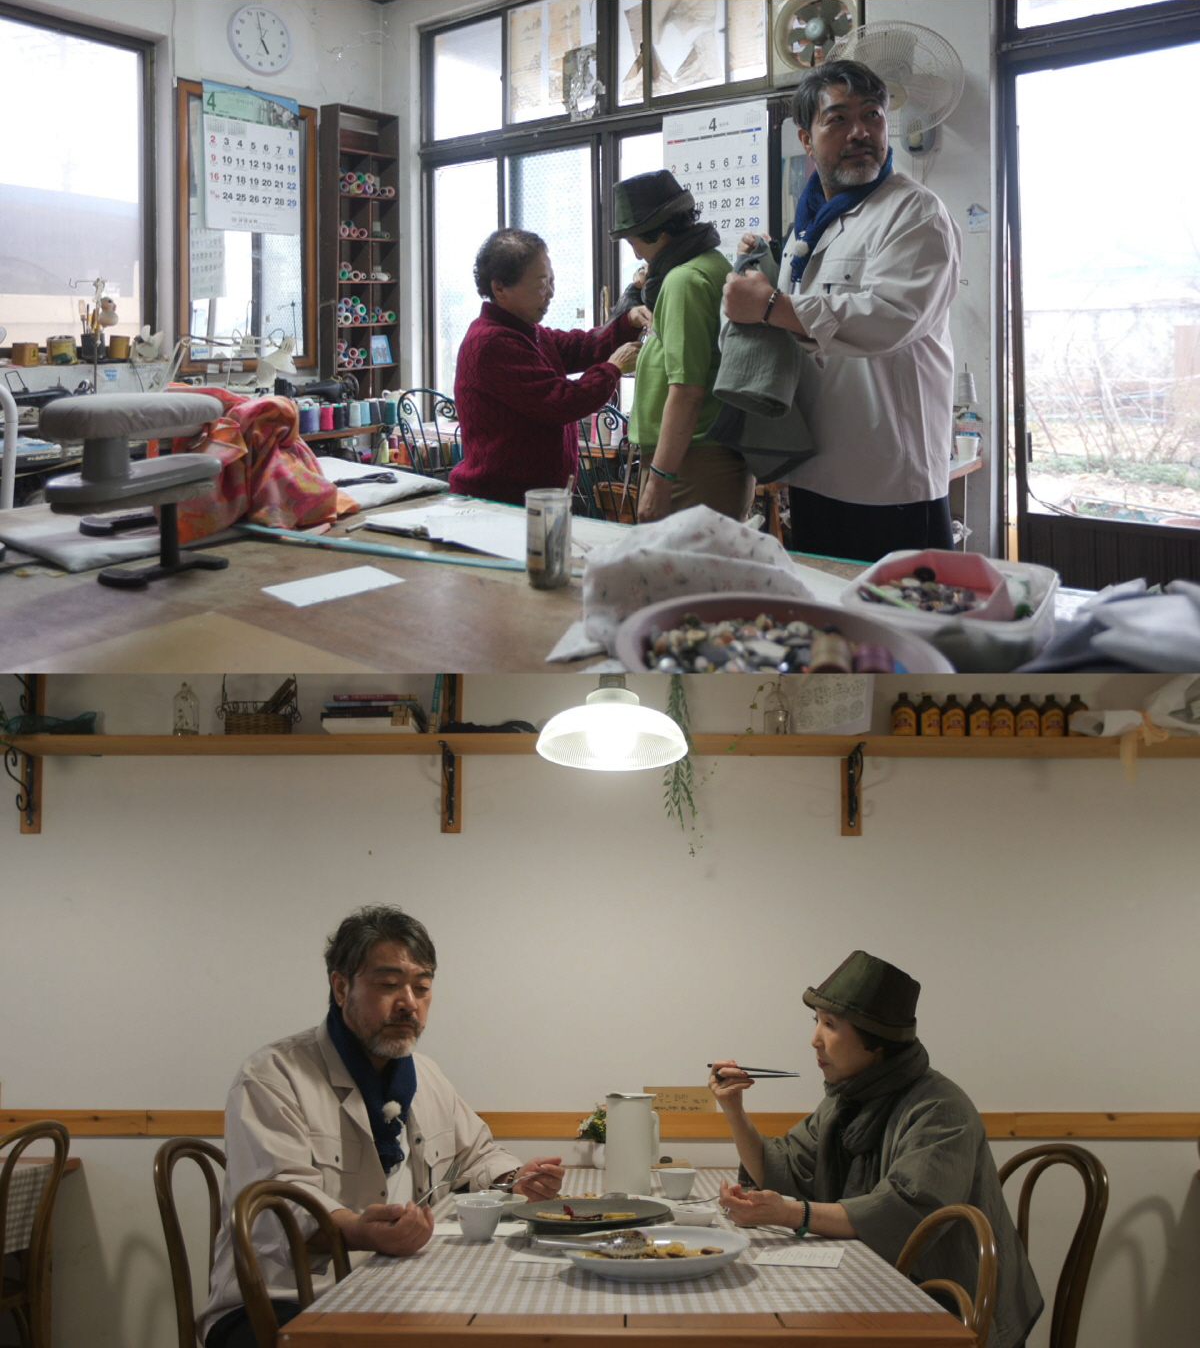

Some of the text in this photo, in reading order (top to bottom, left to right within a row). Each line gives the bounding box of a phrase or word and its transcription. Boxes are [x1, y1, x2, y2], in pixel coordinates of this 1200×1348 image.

[206, 91, 217, 111] 4
[708, 117, 717, 132] 4
[210, 135, 294, 156] 2 3 4 5 6 7 8
[210, 153, 297, 173] 9 10 11 12 13 14 15
[671, 154, 757, 174] 2 3 4 5 6 7 8
[210, 171, 297, 190] 16 17 18 19 20 21 22
[696, 182, 703, 191] 11
[708, 180, 718, 189] 12
[722, 178, 732, 188] 13
[736, 176, 746, 186] 14
[750, 174, 760, 185] 15
[222, 191, 233, 200] 24
[236, 193, 247, 202] 25
[249, 194, 260, 203] 26
[262, 196, 272, 205] 27
[274, 197, 285, 206] 28
[286, 199, 297, 207] 29
[695, 195, 760, 211] 18 19 20 21 22
[721, 218, 731, 229] 27
[734, 217, 745, 228] 28
[749, 216, 760, 227] 29
